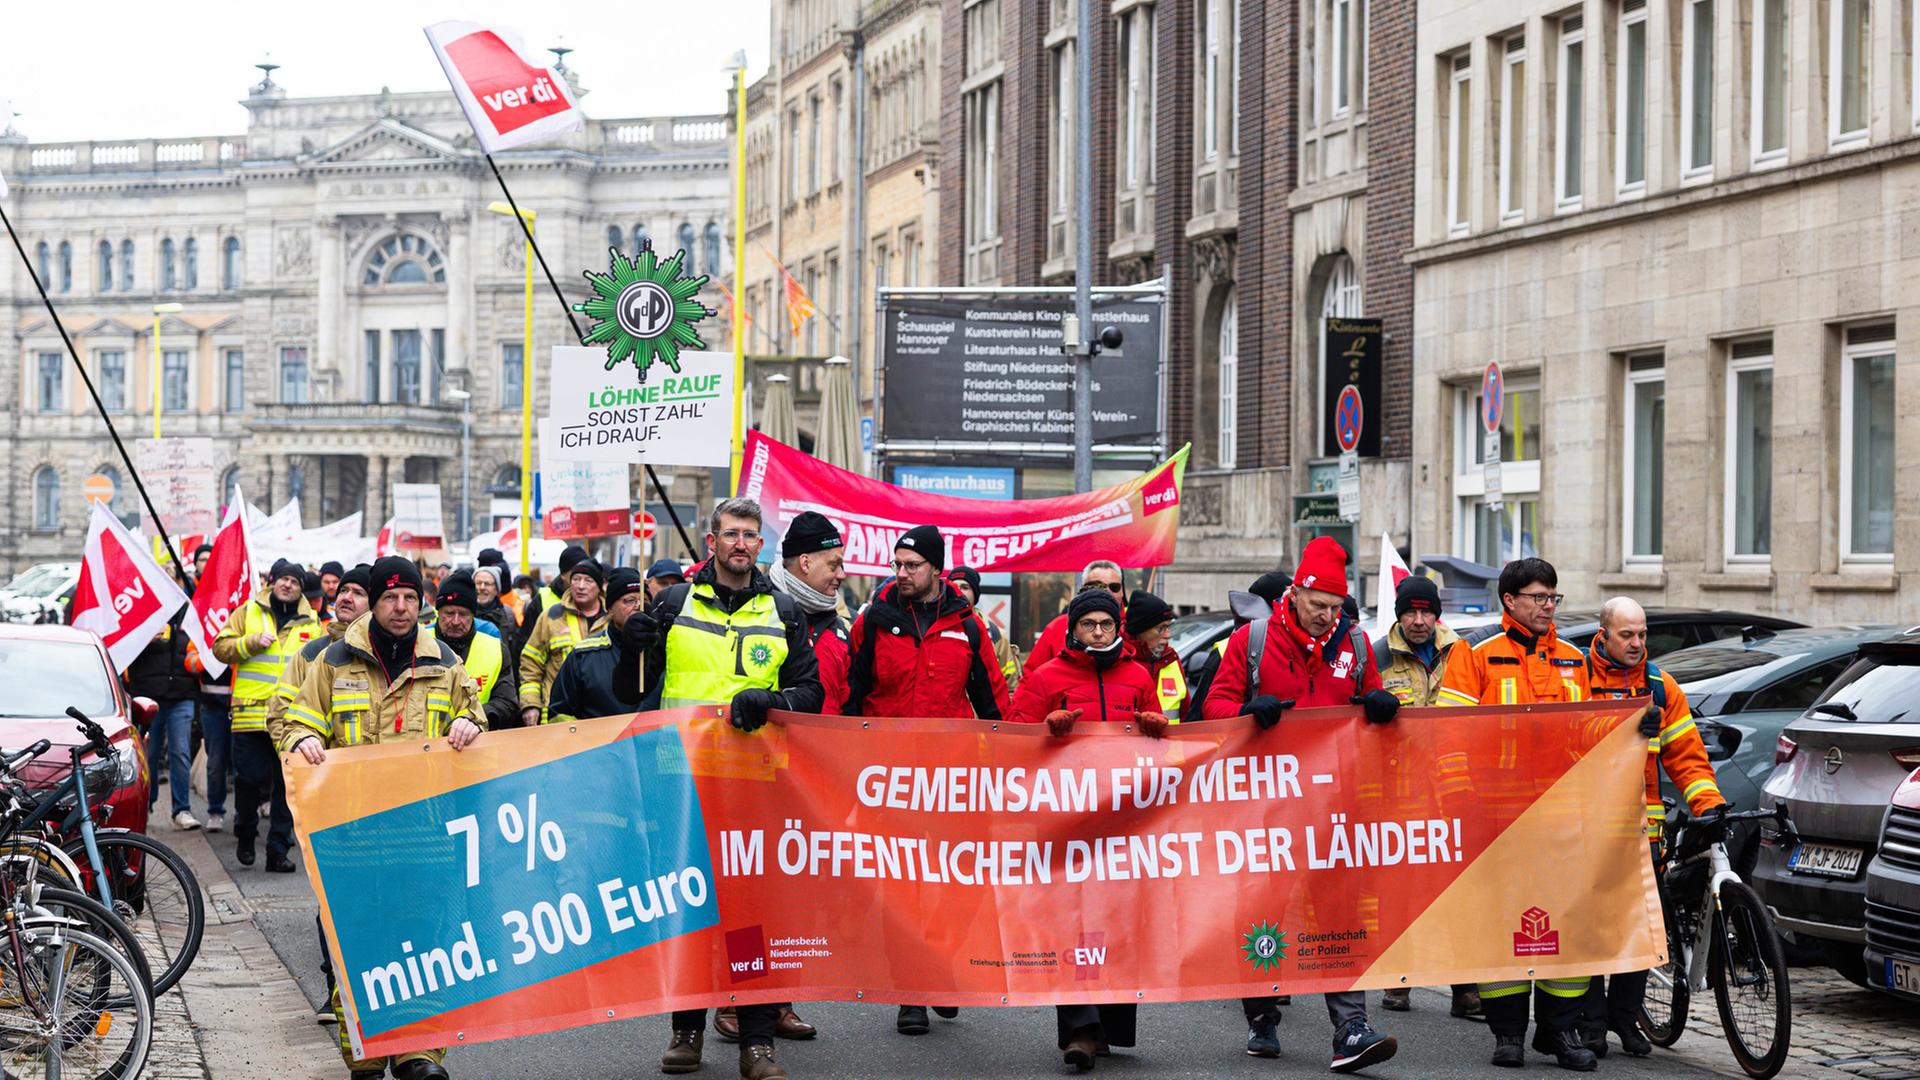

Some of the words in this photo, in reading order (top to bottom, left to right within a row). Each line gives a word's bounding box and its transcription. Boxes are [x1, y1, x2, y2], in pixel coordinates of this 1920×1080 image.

[482, 77, 558, 112] ver.di
[624, 289, 666, 330] GdP
[966, 310, 1034, 321] Kommunales
[1036, 311, 1061, 322] Kino
[1092, 312, 1150, 323] nstlerhaus
[897, 321, 955, 333] Schauspiel
[965, 327, 1029, 338] Kunstverein
[1032, 328, 1063, 338] Hann
[897, 334, 949, 344] Hannover
[964, 344, 1037, 356] Literaturhaus
[963, 361, 1008, 375] Stiftung
[1010, 363, 1077, 374] Niedersachs
[589, 386, 660, 408] LÖHNE
[663, 374, 721, 395] RAUF
[962, 391, 1045, 403] Niedersachsen
[588, 407, 650, 427] SONST
[962, 408, 1045, 420] Hannoverscher
[962, 421, 1031, 434] Graphisches
[1032, 422, 1075, 433] Kabinet
[560, 431, 592, 448] ICH
[597, 425, 661, 445] DRAUF.
[901, 474, 1006, 490] literaturhaus
[856, 765, 1097, 812] GEMEINSAM
[1111, 757, 1183, 811] FÜR
[1189, 754, 1303, 804] MEHR
[445, 814, 480, 888] 7
[497, 793, 567, 871] %
[720, 829, 764, 876] IM
[777, 818, 1053, 885] ÖFFENTLICHEN
[1065, 832, 1202, 883] DIENST
[1215, 827, 1296, 875] DER
[1305, 813, 1463, 870] LÄNDER!
[1797, 846, 1812, 865] HK
[1817, 850, 1834, 867] JF
[1831, 850, 1860, 872] 2011
[361, 921, 498, 1011] mind.
[502, 892, 591, 965] 300
[597, 866, 707, 934] Euro
[770, 937, 828, 946] Landesbezirk
[1297, 929, 1367, 943] Gewerkschaft
[1012, 951, 1056, 959] Gewerkschaft
[1062, 947, 1106, 966] GEW
[1297, 947, 1314, 957] der
[1317, 944, 1350, 955] Polizei
[770, 961, 803, 970] Bremen
[970, 959, 1000, 967] Erziehung
[1297, 961, 1355, 970] Niedersachsen
[1894, 962, 1910, 989] GT
